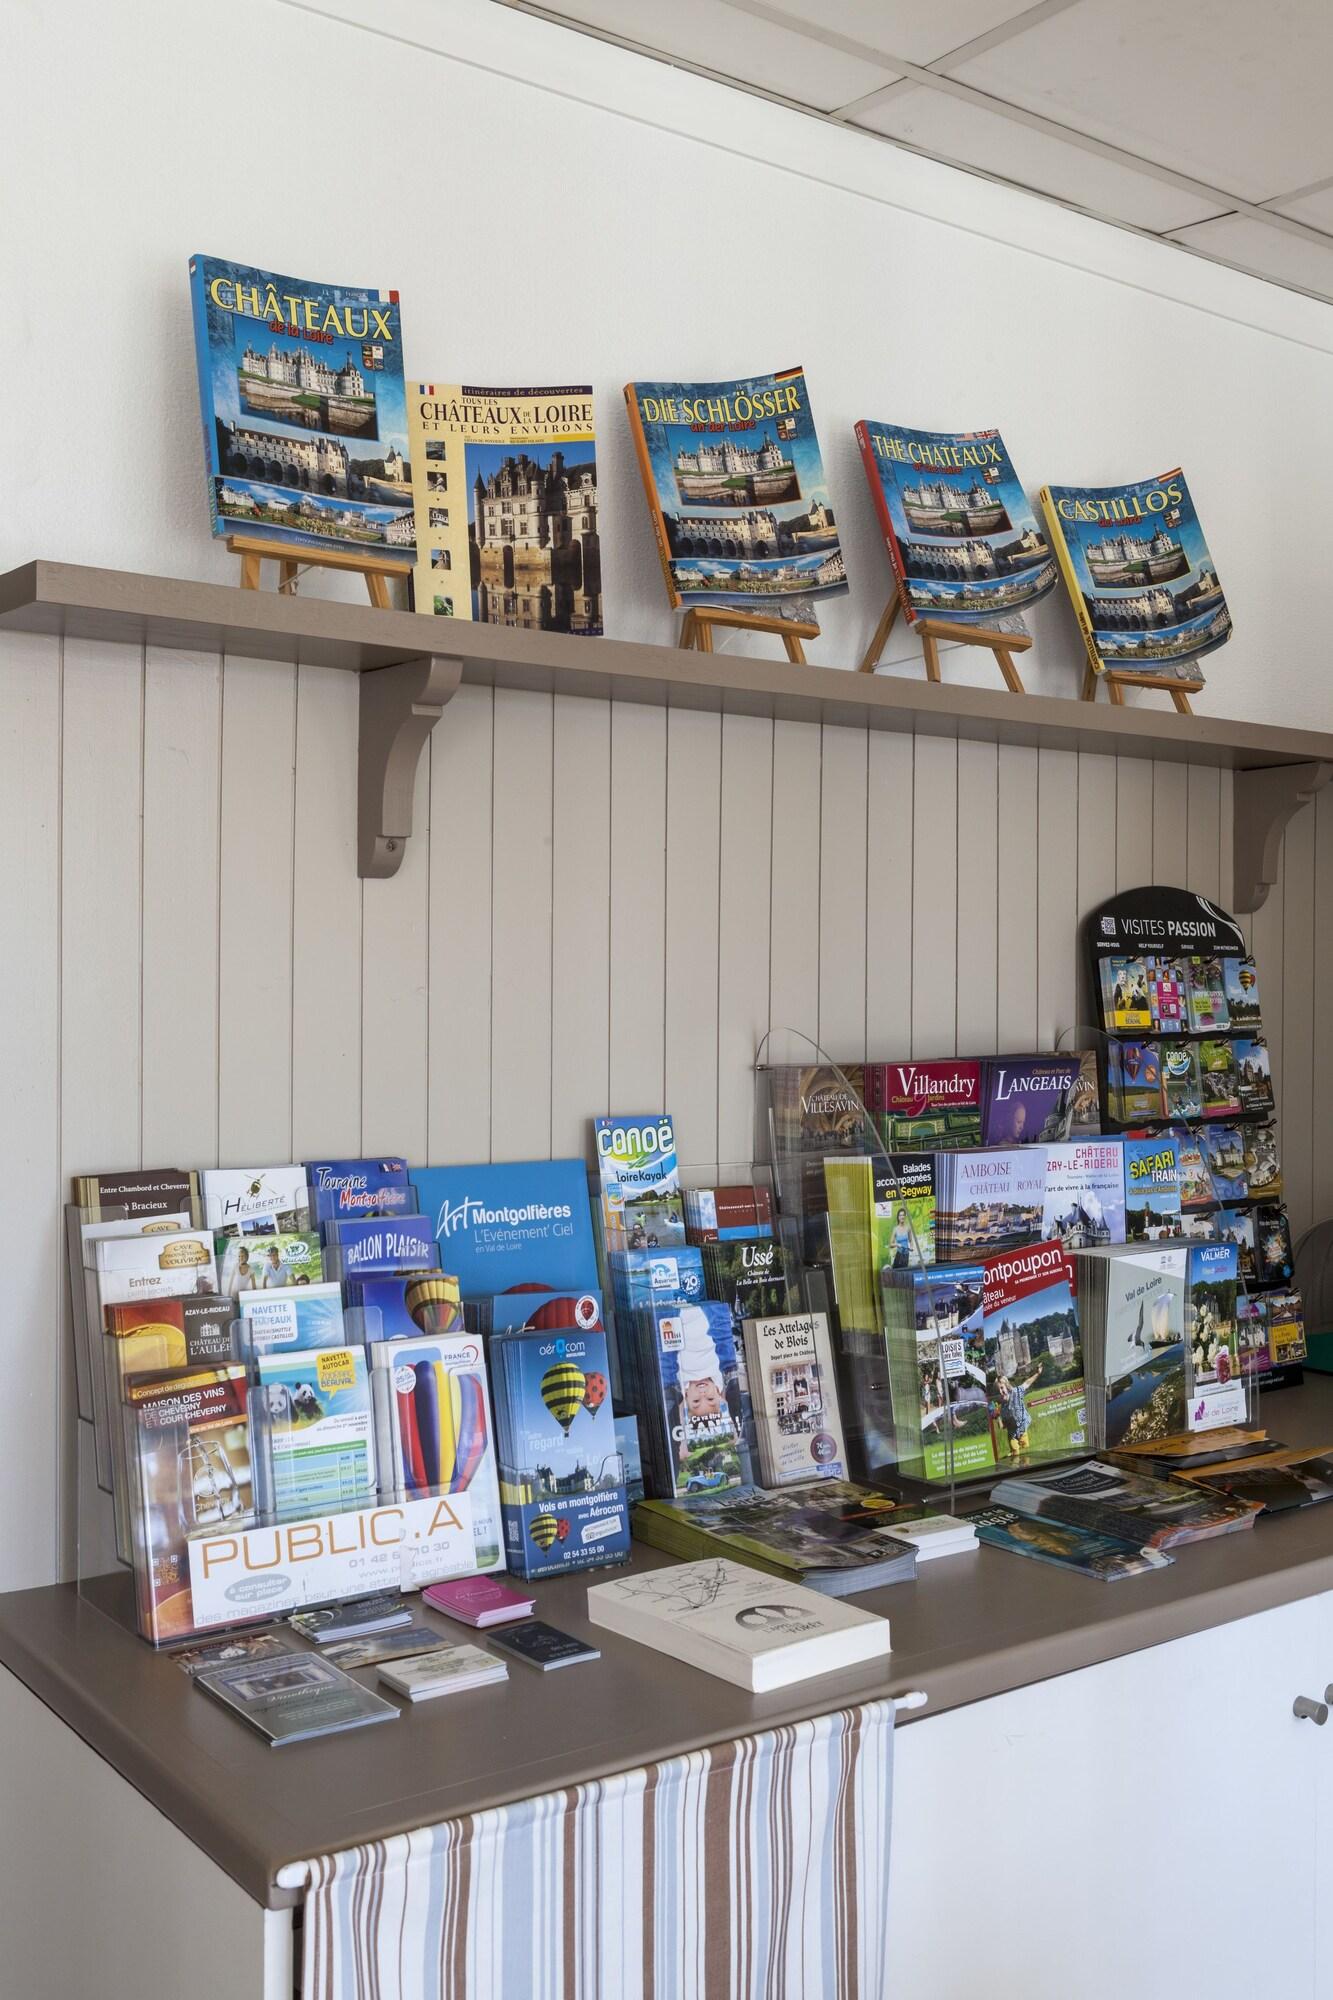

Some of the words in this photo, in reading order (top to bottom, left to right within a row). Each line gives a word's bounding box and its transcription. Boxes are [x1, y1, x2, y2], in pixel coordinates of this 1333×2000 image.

[210, 277, 393, 341] CHÂTEAUX
[269, 320, 283, 333] de
[288, 322, 299, 337] la
[303, 326, 334, 345] Loire
[463, 388, 511, 396] itinéraires
[514, 388, 525, 396] de
[528, 387, 583, 396] découvertes
[461, 397, 483, 405] TOUS
[643, 398, 679, 424] DIE
[684, 386, 801, 423] SCHLÖSSER
[420, 400, 522, 424] CHÂTEAUX
[535, 404, 593, 424] LOIRE
[423, 421, 440, 430] ET
[450, 424, 500, 434] LEURS
[511, 423, 593, 435] ENVIRONS
[690, 422, 704, 433] an
[708, 421, 726, 433] der
[728, 419, 757, 432] Loire
[872, 435, 906, 461] THE
[908, 442, 1002, 467] CHATEAUX
[1057, 483, 1183, 521] CASTILLOS
[1121, 918, 1166, 936] VISITES
[1167, 920, 1216, 937] PASSION
[897, 1067, 976, 1098] Villandry
[995, 1070, 1072, 1101] LANGEAIS
[801, 1096, 860, 1114] VILLESAVIN
[597, 1119, 675, 1157] canoë
[902, 1163, 931, 1174] Balades
[961, 1161, 1012, 1179] AMBOISE
[1047, 1159, 1118, 1172] ZAY-LE-RIDEAU
[1129, 1150, 1175, 1180] SAFARI
[316, 1166, 368, 1192] Touraine
[1151, 1169, 1177, 1183] TRAIN
[118, 1185, 152, 1193] Chambord
[160, 1183, 189, 1191] Cheverny
[885, 1189, 896, 1199] en
[900, 1185, 932, 1199] Segway
[969, 1181, 1010, 1196] CHÂTEAU
[1017, 1179, 1044, 1192] ROYAL
[1092, 1182, 1119, 1191] française
[131, 1201, 168, 1211] Bracieux
[435, 1196, 483, 1239] Art
[473, 1204, 571, 1226] Montgolfières
[552, 1223, 573, 1237] Ciel
[347, 1234, 382, 1265] BALLON
[386, 1232, 429, 1259] PLAISIR
[485, 1244, 496, 1252] Val
[497, 1243, 504, 1251] de
[505, 1242, 522, 1251] Loire
[1201, 1248, 1230, 1262] VALMER
[742, 1244, 774, 1267] Ussé
[983, 1249, 1062, 1285] ontpoupon
[129, 1277, 162, 1287] Entrez
[685, 1275, 698, 1291] 20
[1125, 1290, 1135, 1302] Val
[1137, 1287, 1145, 1297] de
[1146, 1277, 1162, 1291] Loire
[983, 1289, 1004, 1304] âteau
[185, 1305, 230, 1316] AZAY-LE-RIDEAU
[251, 1304, 288, 1315] NAVETTE
[763, 1324, 776, 1336] Les
[189, 1336, 221, 1347] CHÂTEAU
[774, 1338, 784, 1350] de
[786, 1335, 808, 1348] Blois
[321, 1352, 347, 1362] NAVETTE
[444, 1352, 471, 1361] FRANCE
[322, 1360, 349, 1370] AUTOCAR
[137, 1387, 164, 1398] Concept
[182, 1391, 202, 1404] DES
[203, 1387, 225, 1399] VINS
[158, 1402, 201, 1418] CHEVERNY
[160, 1413, 184, 1426] COUR
[184, 1404, 227, 1420] CHEVERNY
[539, 1501, 556, 1513] Vols
[557, 1501, 567, 1510] en
[569, 1491, 618, 1507] montgolfière
[590, 1503, 624, 1518] Aérocom
[202, 1499, 464, 1580] PUBLIC.A
[349, 1557, 365, 1568] 01
[371, 1554, 387, 1563] 42
[433, 1541, 450, 1552] 30
[563, 1551, 571, 1559] 02
[572, 1550, 579, 1558] 54
[580, 1548, 588, 1556] 33
[588, 1547, 596, 1555] 55
[238, 1577, 287, 1593] consulter
[235, 1592, 253, 1601] sur
[255, 1586, 285, 1600] place
[196, 1612, 222, 1625] des
[341, 1583, 365, 1595] une
